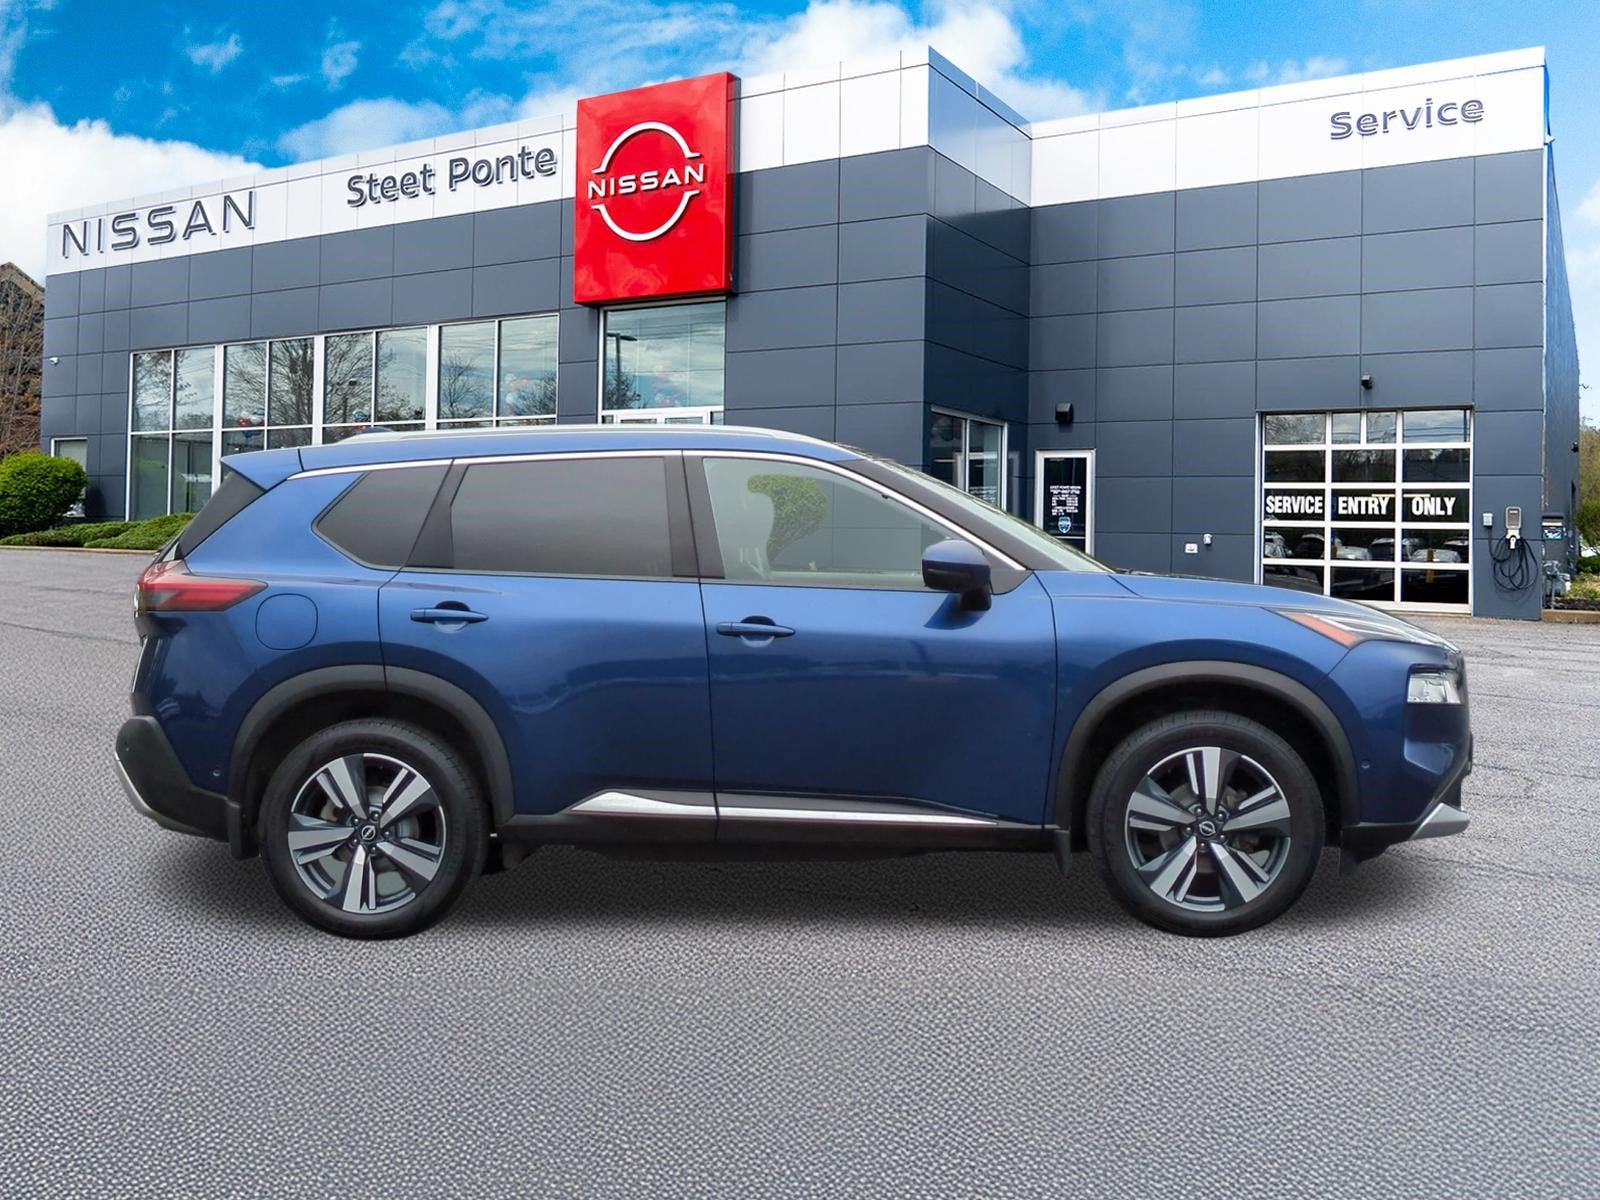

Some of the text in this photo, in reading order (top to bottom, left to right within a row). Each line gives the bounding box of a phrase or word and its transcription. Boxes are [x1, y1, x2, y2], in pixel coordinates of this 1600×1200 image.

[1330, 98, 1485, 140] Service
[347, 146, 556, 207] Steet Ponte
[588, 164, 704, 200] NISSAN
[63, 191, 256, 258] NISSAN
[1265, 495, 1456, 515] SERVICE ENTRY ONLY
